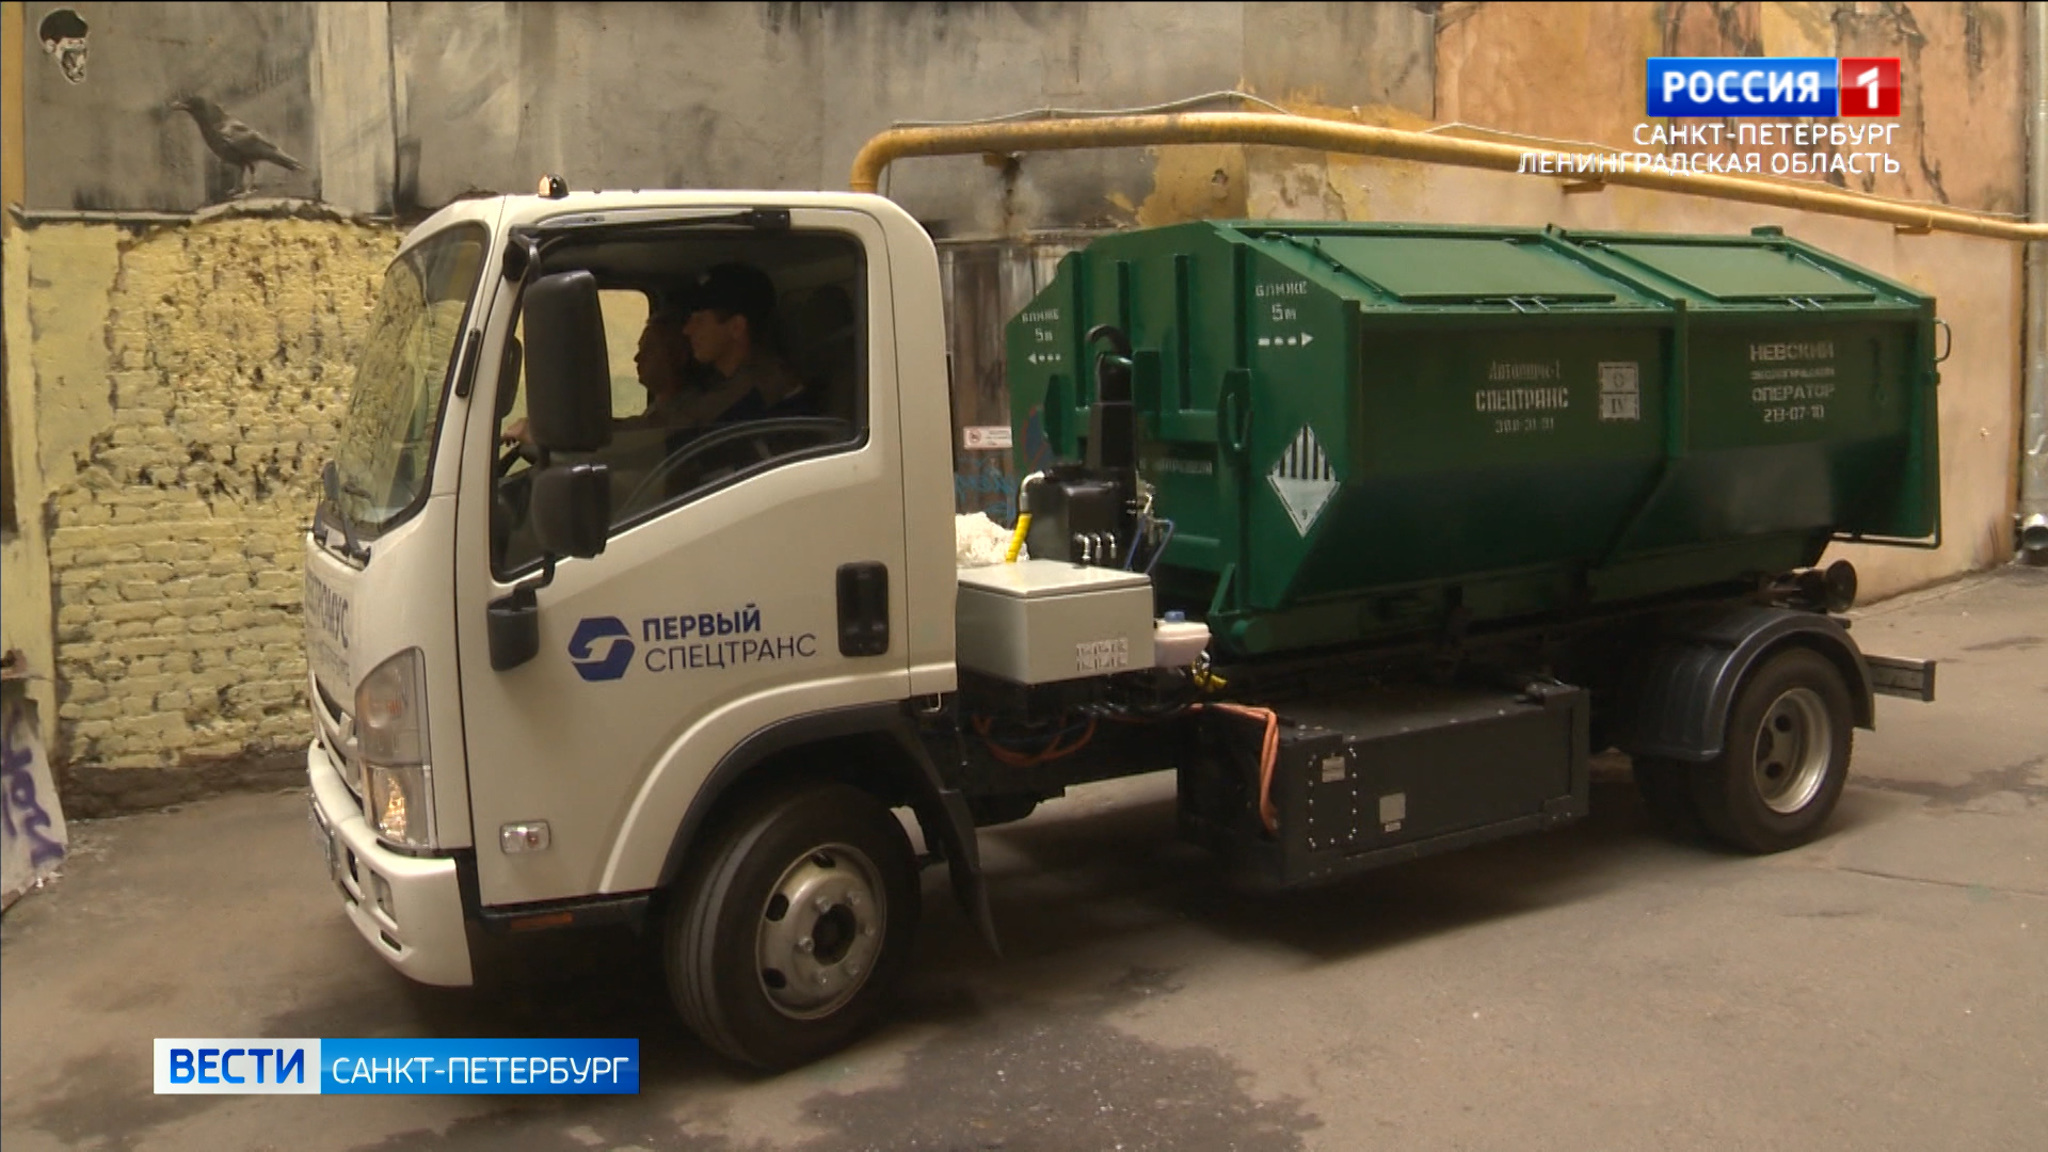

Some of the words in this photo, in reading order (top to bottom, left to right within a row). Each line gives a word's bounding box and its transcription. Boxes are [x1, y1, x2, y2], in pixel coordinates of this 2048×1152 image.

[1475, 387, 1569, 412] СПЕЦТРАНС
[1751, 383, 1836, 402] ОПЕРАТОР
[643, 603, 762, 642] ПЕРВЫЙ
[645, 633, 817, 673] СПЕЦТРАНС
